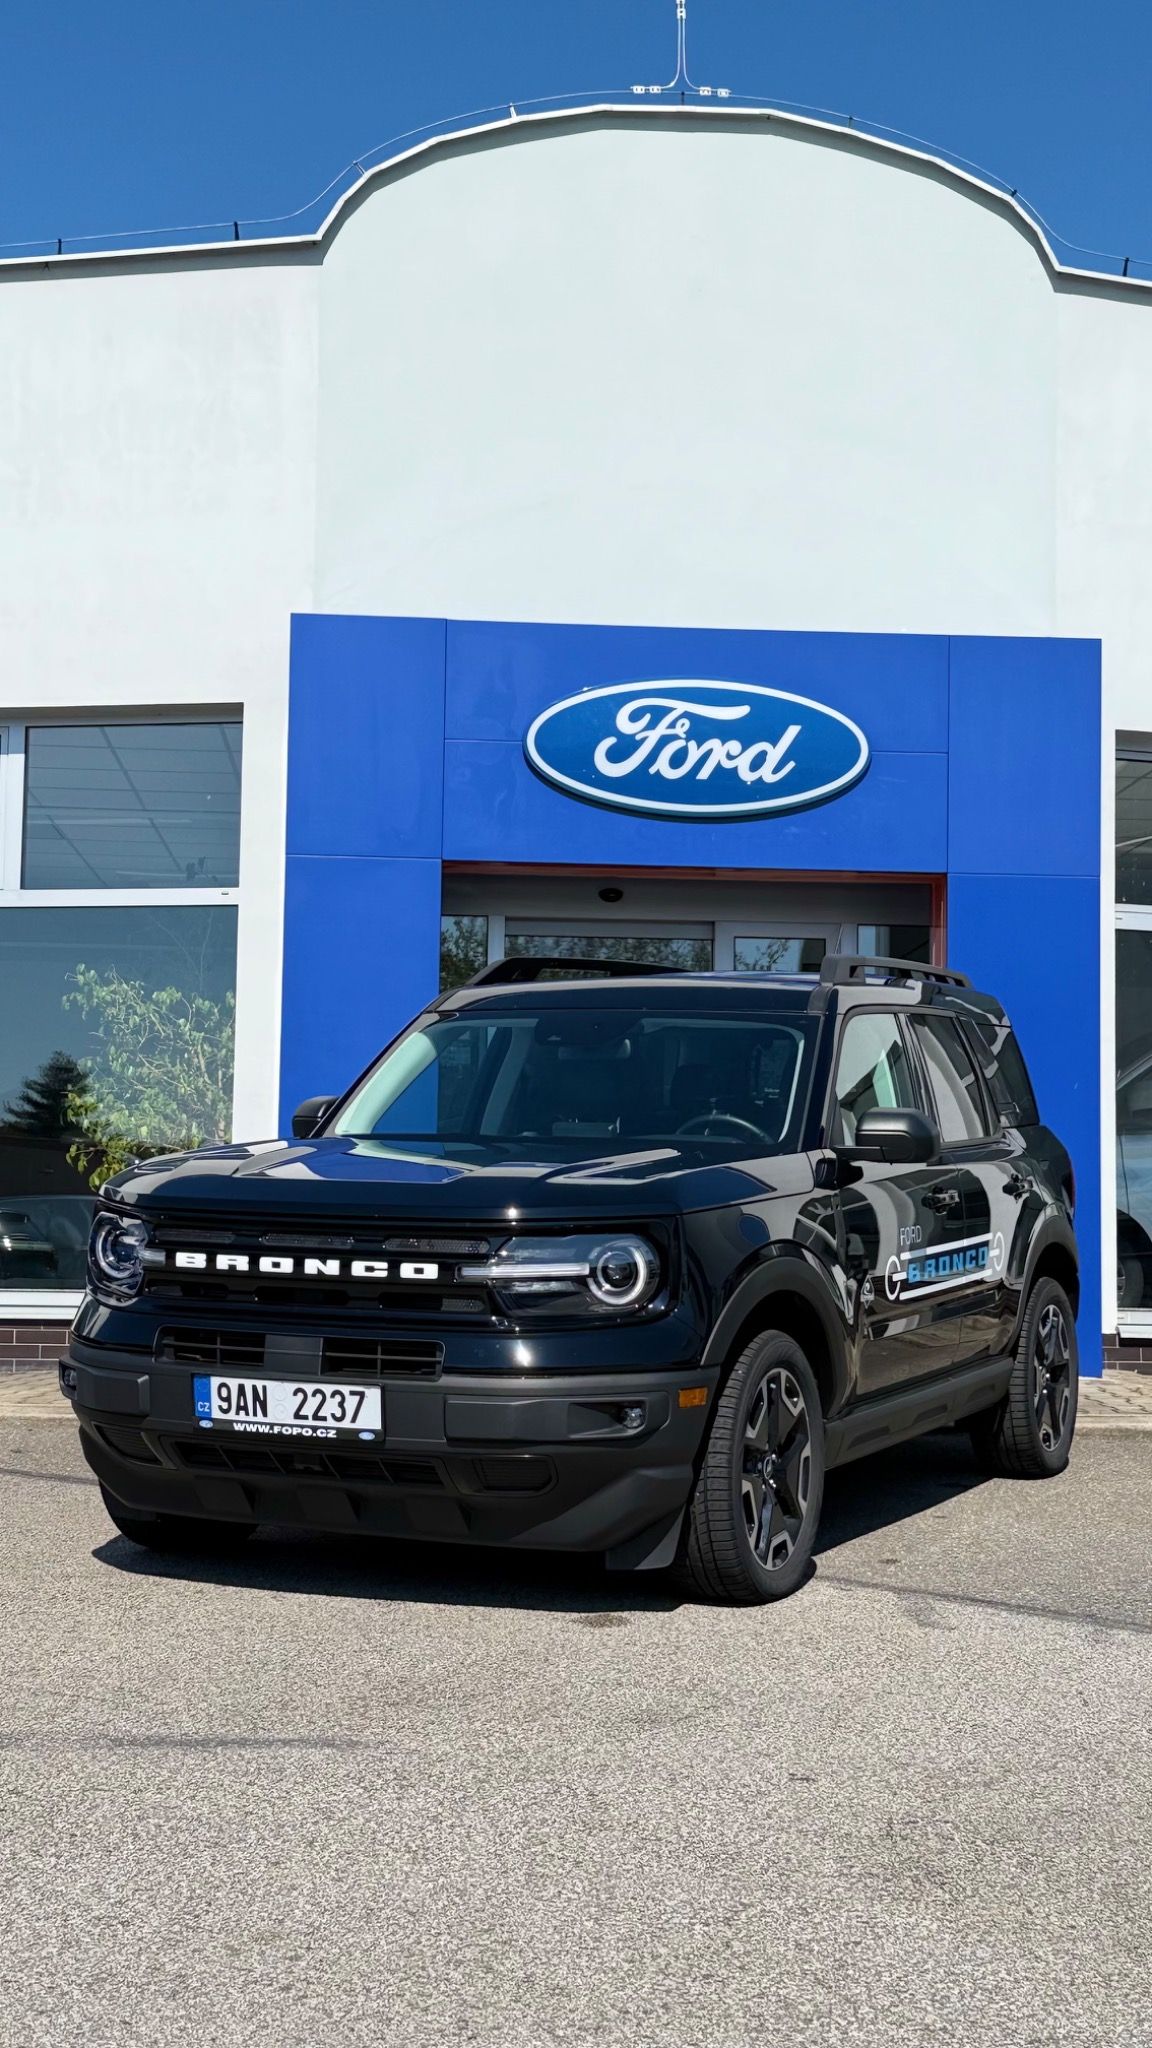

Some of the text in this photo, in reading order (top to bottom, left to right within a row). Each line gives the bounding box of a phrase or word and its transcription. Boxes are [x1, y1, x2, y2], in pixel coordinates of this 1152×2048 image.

[593, 697, 802, 784] Ford
[900, 1225, 922, 1246] FORD
[175, 1251, 439, 1279] BRONCO
[908, 1246, 989, 1283] BRONCO
[197, 1401, 210, 1412] CZ
[217, 1382, 366, 1424] 9AN 2237
[233, 1422, 337, 1438] WWW.FOPO.CZ
